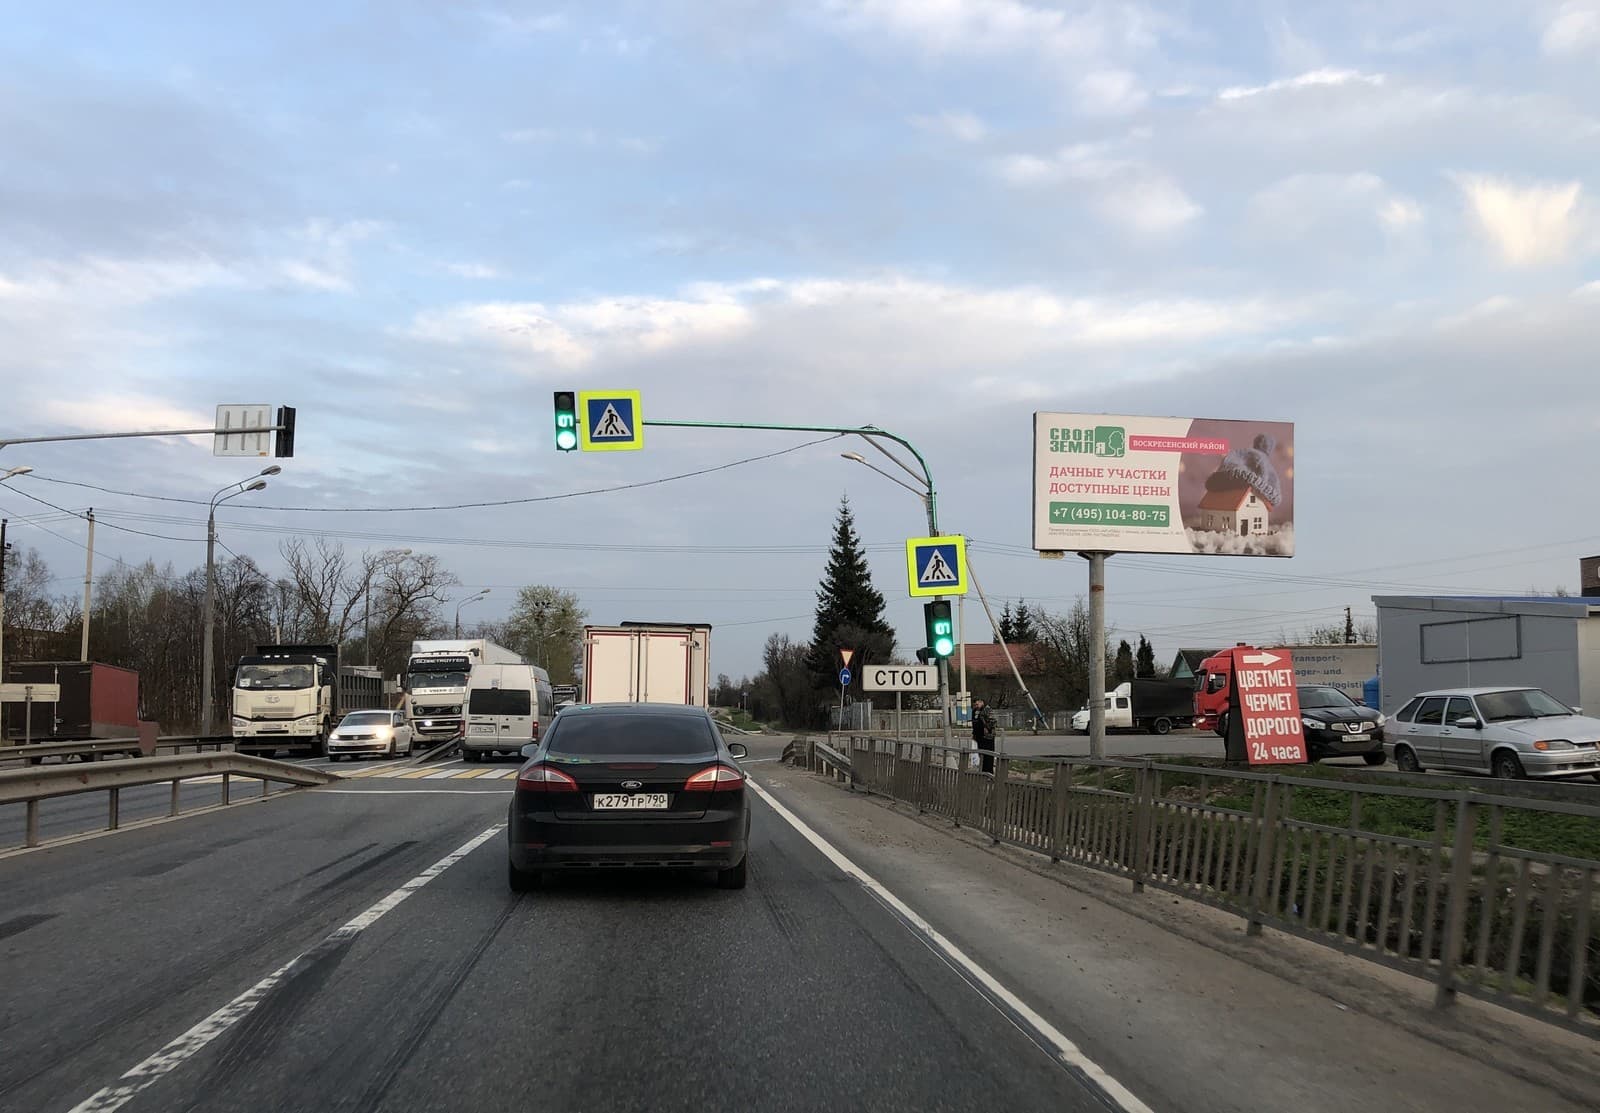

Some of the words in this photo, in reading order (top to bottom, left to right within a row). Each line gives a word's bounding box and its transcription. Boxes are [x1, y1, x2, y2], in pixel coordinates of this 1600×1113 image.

[1049, 428, 1094, 441] СВОЯ
[1133, 439, 1198, 449] ВОСКРЕСЕНСКИЙ
[1200, 441, 1225, 450] РАЙОН
[1049, 467, 1104, 478] ДАЧНЫЕ
[1107, 469, 1167, 481] УЧАСТКИ
[1049, 483, 1130, 495] ДОСТУПНЫЕ
[1133, 485, 1171, 497] ЦЕНЫ
[1053, 508, 1068, 518] +7
[1071, 508, 1102, 520] (495)
[1105, 509, 1167, 521] 104-80-75
[875, 670, 926, 686] СТОП
[1238, 669, 1292, 691] ЦВЕТМЕТ
[1245, 693, 1291, 711] ЧЕРМЕТ
[1247, 717, 1300, 738] ДОРОГО
[1252, 742, 1268, 760] 24
[1271, 745, 1301, 760] часа
